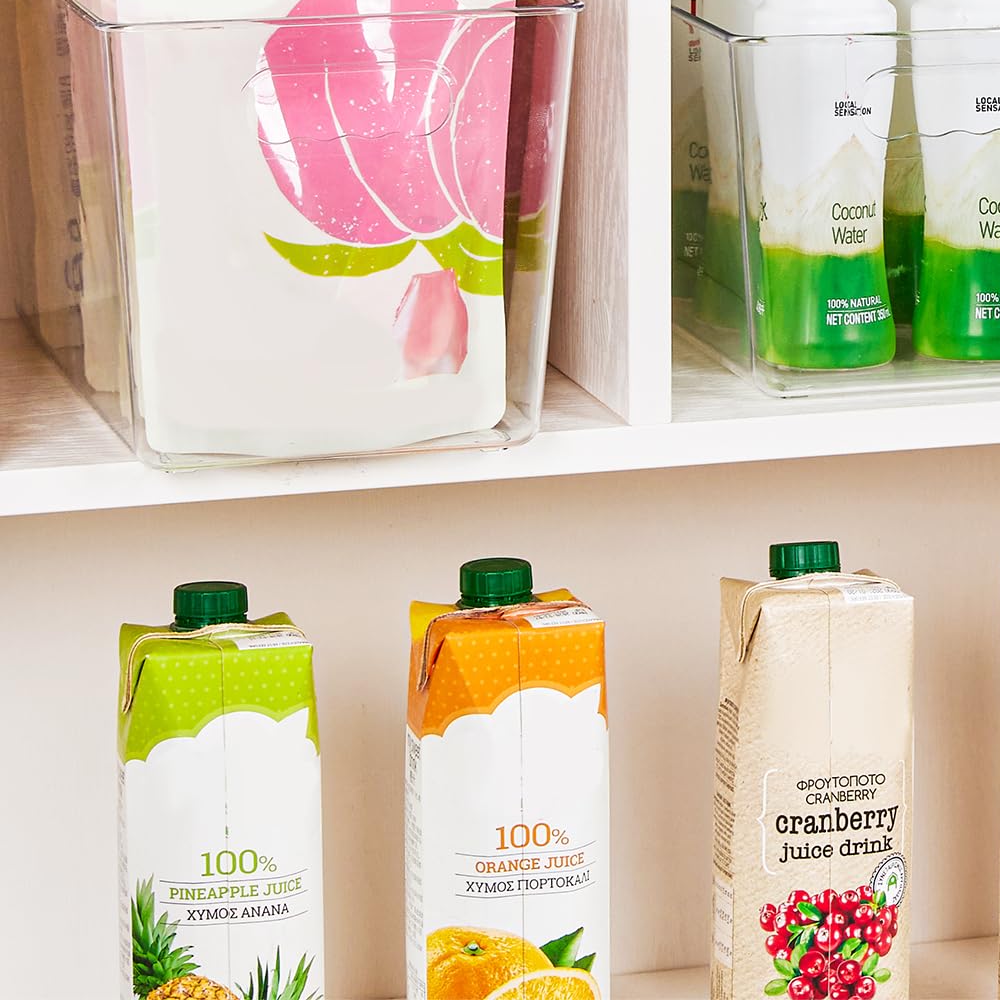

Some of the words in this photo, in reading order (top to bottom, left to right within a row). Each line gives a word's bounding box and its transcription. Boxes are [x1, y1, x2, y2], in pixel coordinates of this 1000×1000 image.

[832, 202, 877, 220] Coconut
[832, 226, 868, 244] Water
[827, 299, 849, 309] 100%
[850, 295, 882, 308] NATURAL
[975, 291, 999, 303] 100%
[826, 313, 843, 326] NET
[843, 309, 877, 326] CONTENT
[975, 306, 994, 320] NET
[805, 788, 877, 805] CRANBERRY
[775, 805, 899, 835] cranberry
[495, 822, 570, 851] 100%
[779, 842, 834, 864] juice
[839, 835, 893, 857] drink
[201, 849, 277, 877] 100%
[475, 858, 540, 874] ORANGE
[544, 852, 585, 869] JUICE
[169, 884, 259, 901] PINEAPPLE
[263, 877, 302, 896] JUICE
[466, 880, 514, 893] ΧΥΜΟΣ
[187, 907, 238, 921] ΧΥΜΟΣ
[241, 903, 290, 918] ΑΝΑΝΑ
